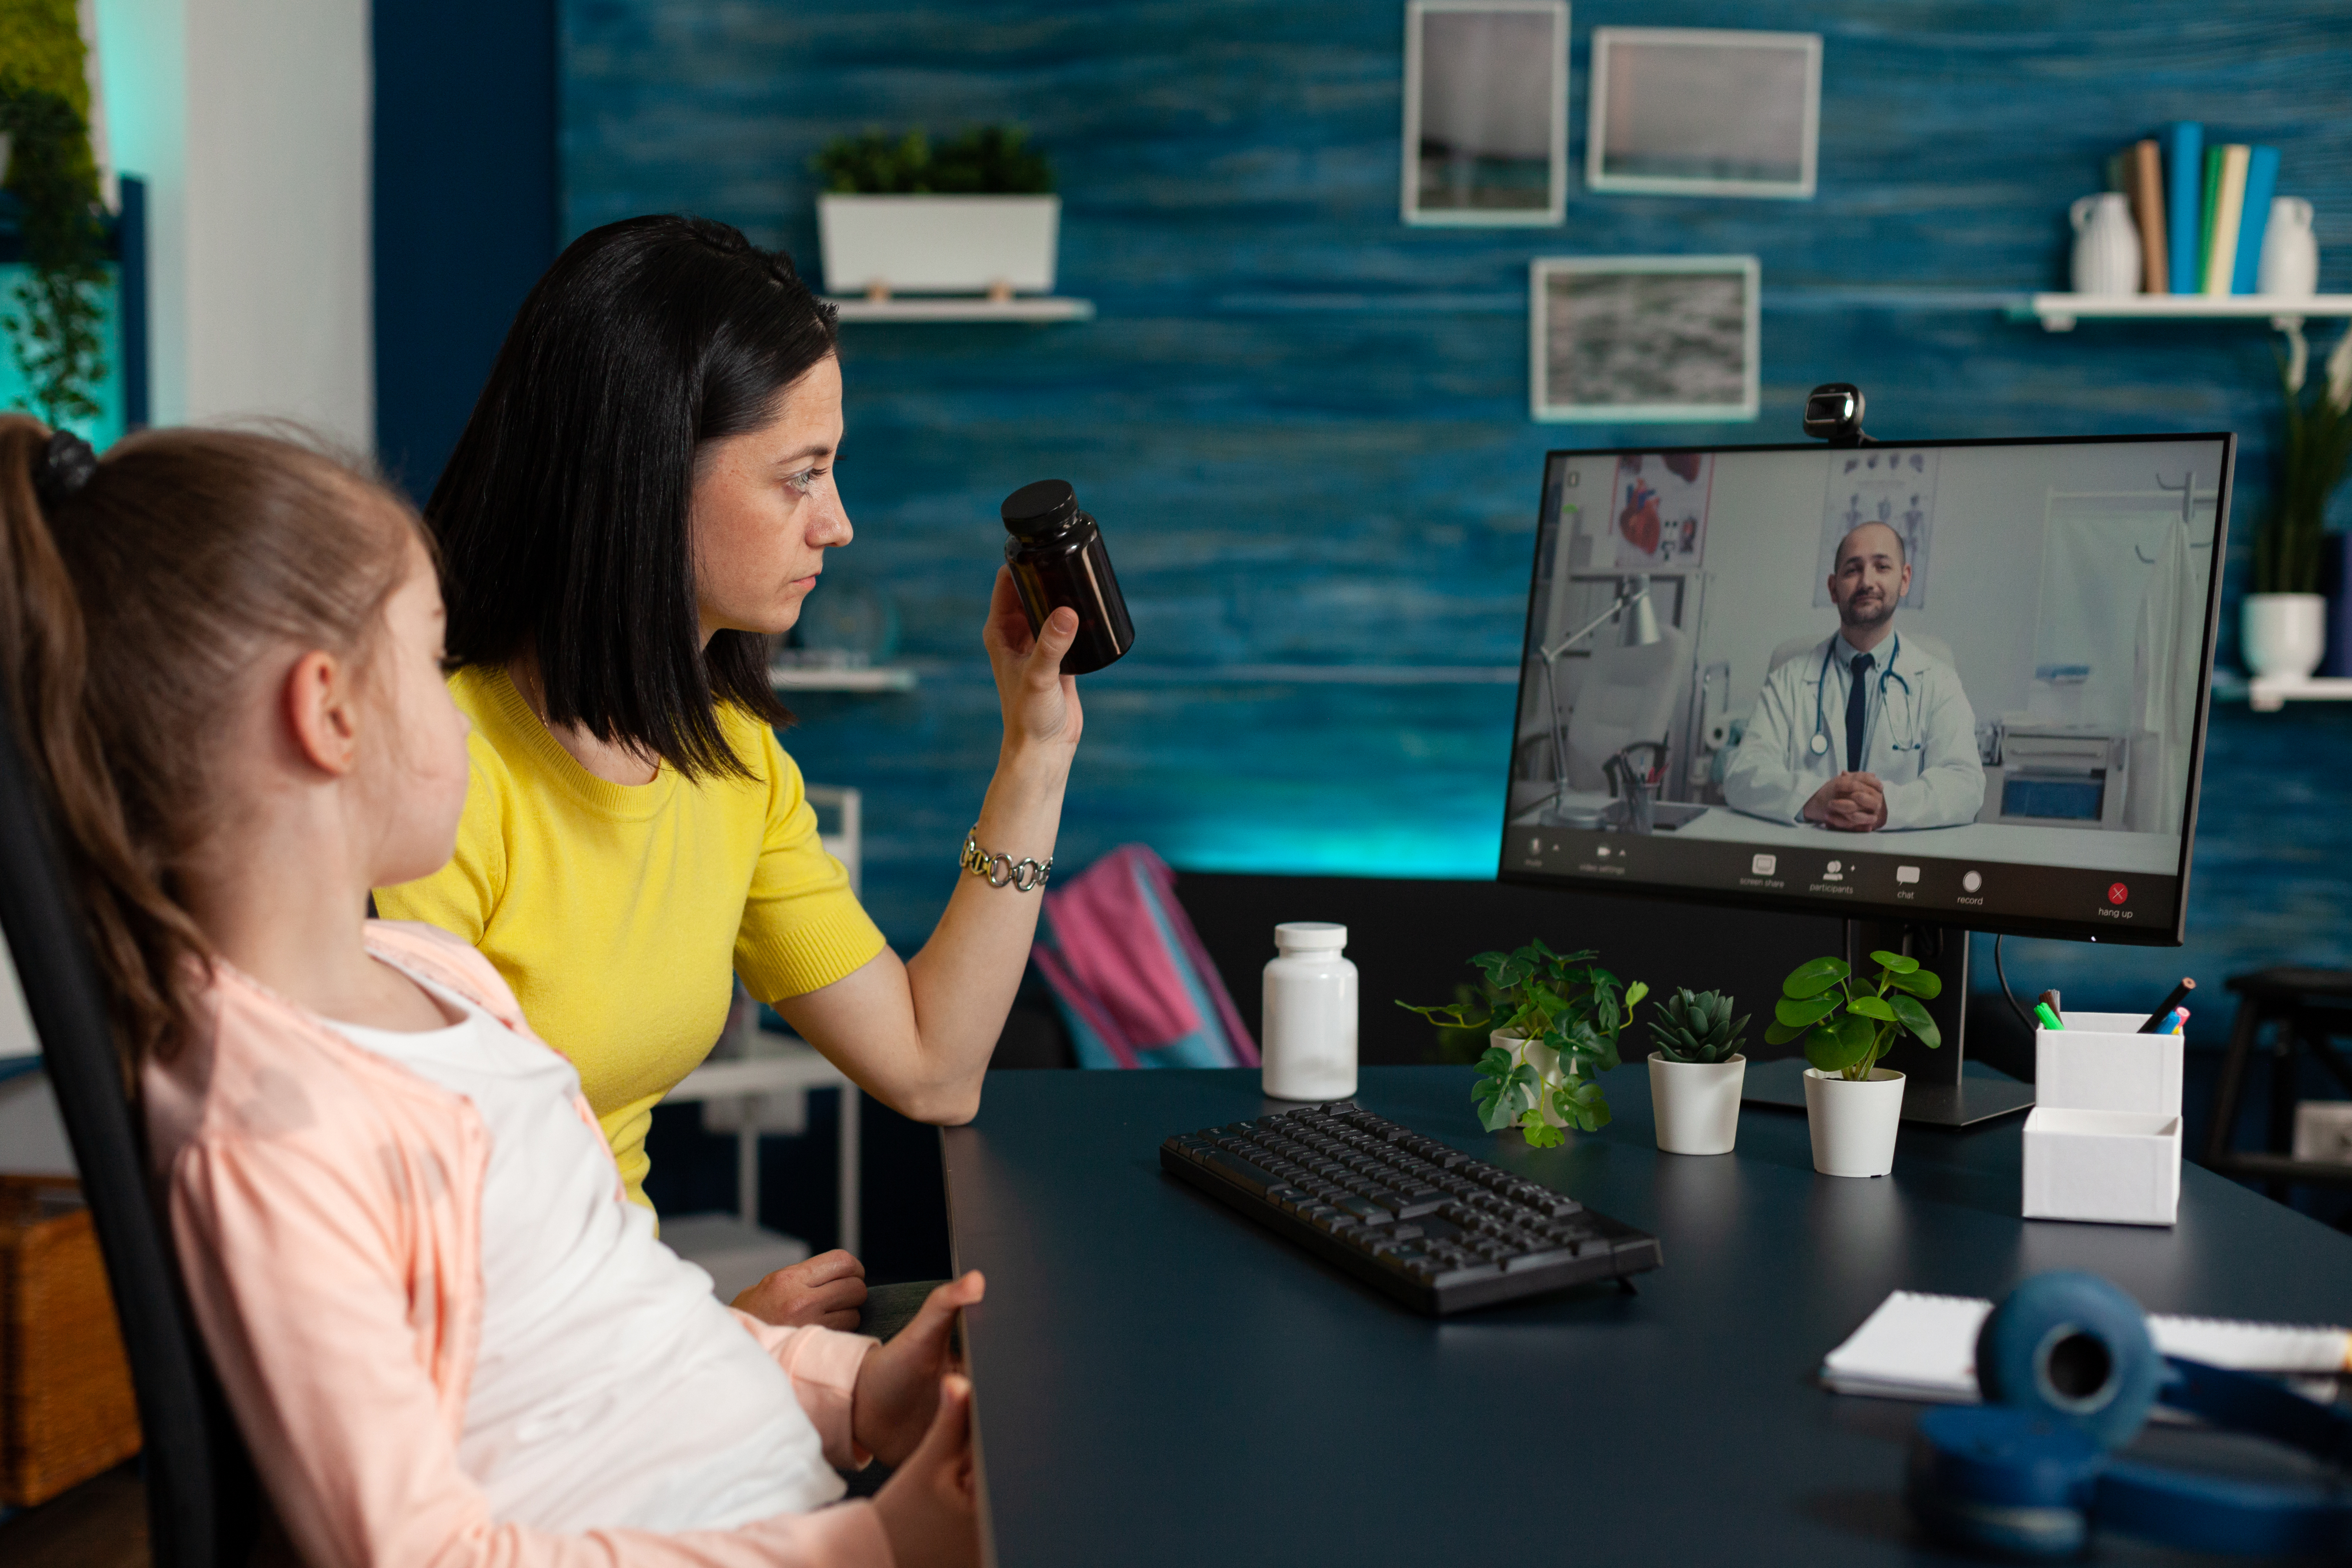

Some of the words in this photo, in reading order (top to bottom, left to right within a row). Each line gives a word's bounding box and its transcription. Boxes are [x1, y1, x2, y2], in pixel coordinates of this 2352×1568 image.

[1740, 878, 1763, 886] screen
[1765, 879, 1785, 889] share
[1809, 883, 1853, 894] participants
[1897, 890, 1914, 900] chat
[1957, 895, 1983, 905] record
[2098, 908, 2120, 918] hang
